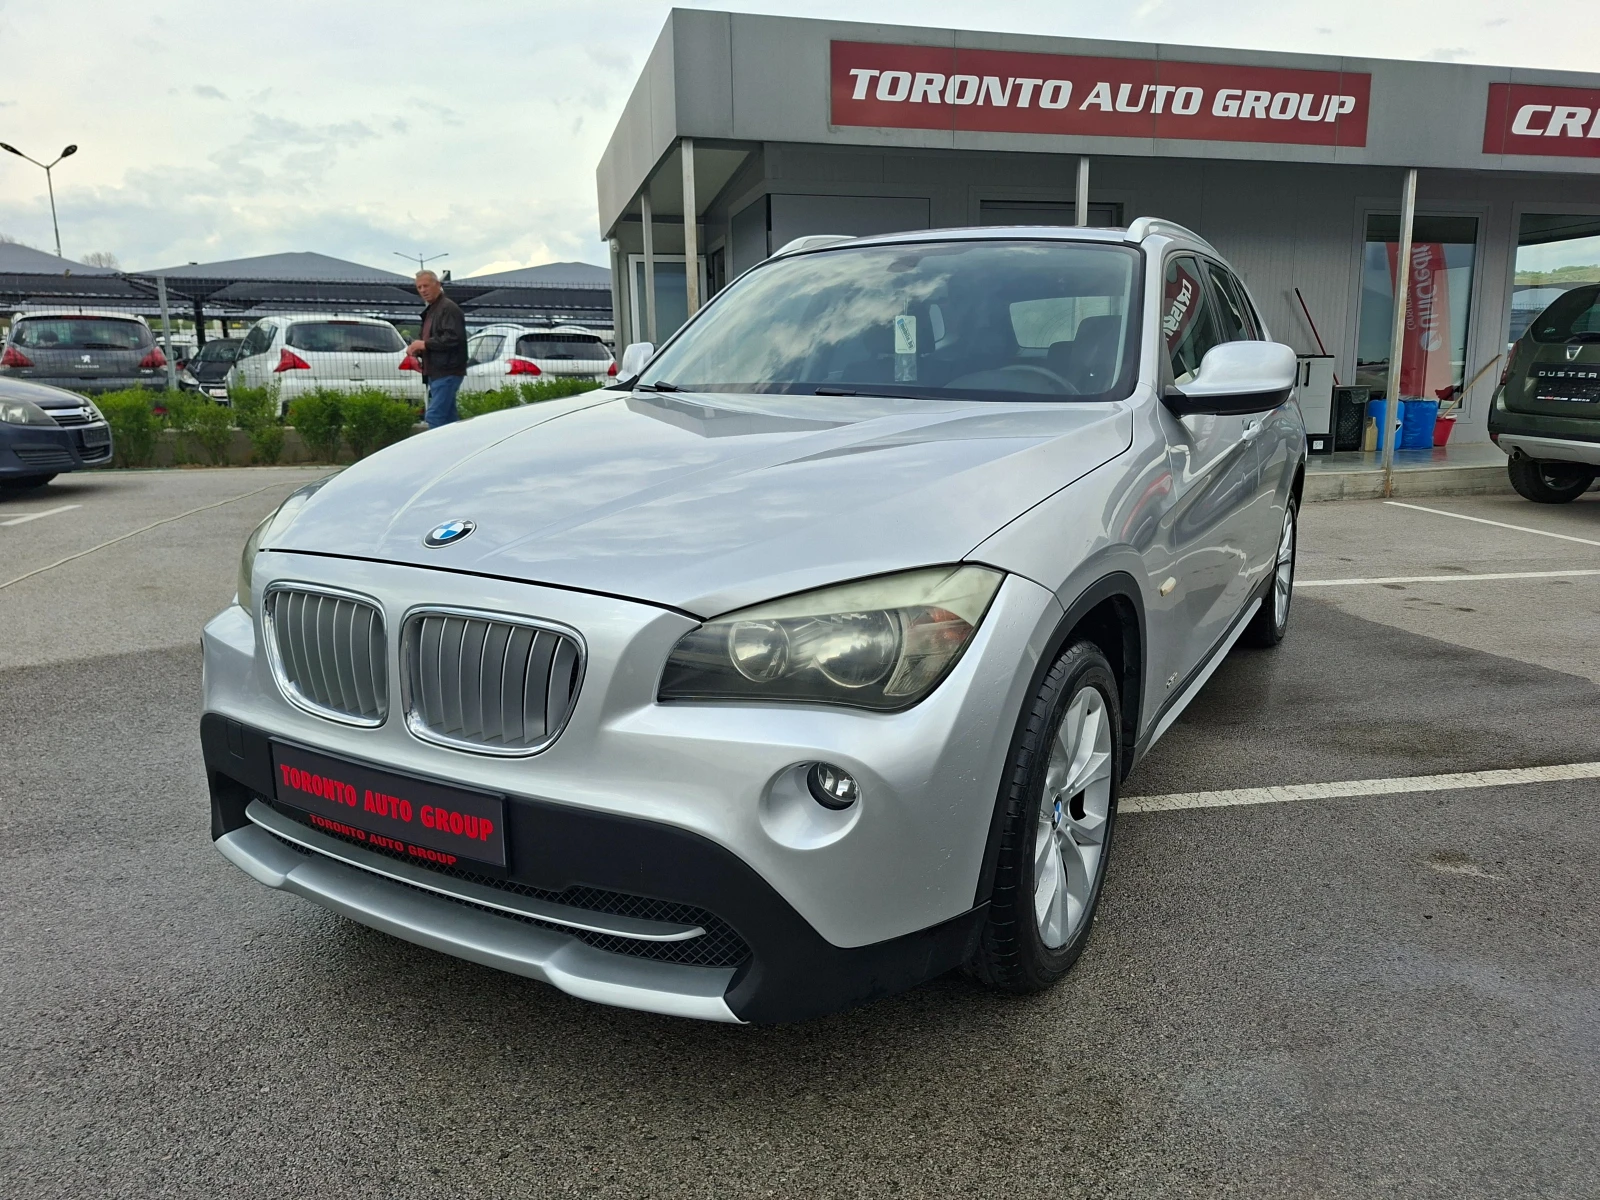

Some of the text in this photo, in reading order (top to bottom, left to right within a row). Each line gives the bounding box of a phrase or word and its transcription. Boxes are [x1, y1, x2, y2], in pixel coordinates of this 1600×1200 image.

[849, 68, 1356, 123] TORONTO AUTO GROUP
[1538, 370, 1598, 379] DUSTER
[280, 763, 494, 842] TORONTO AUTO GROUP
[310, 814, 457, 866] TORONTO AUTO GROUP
